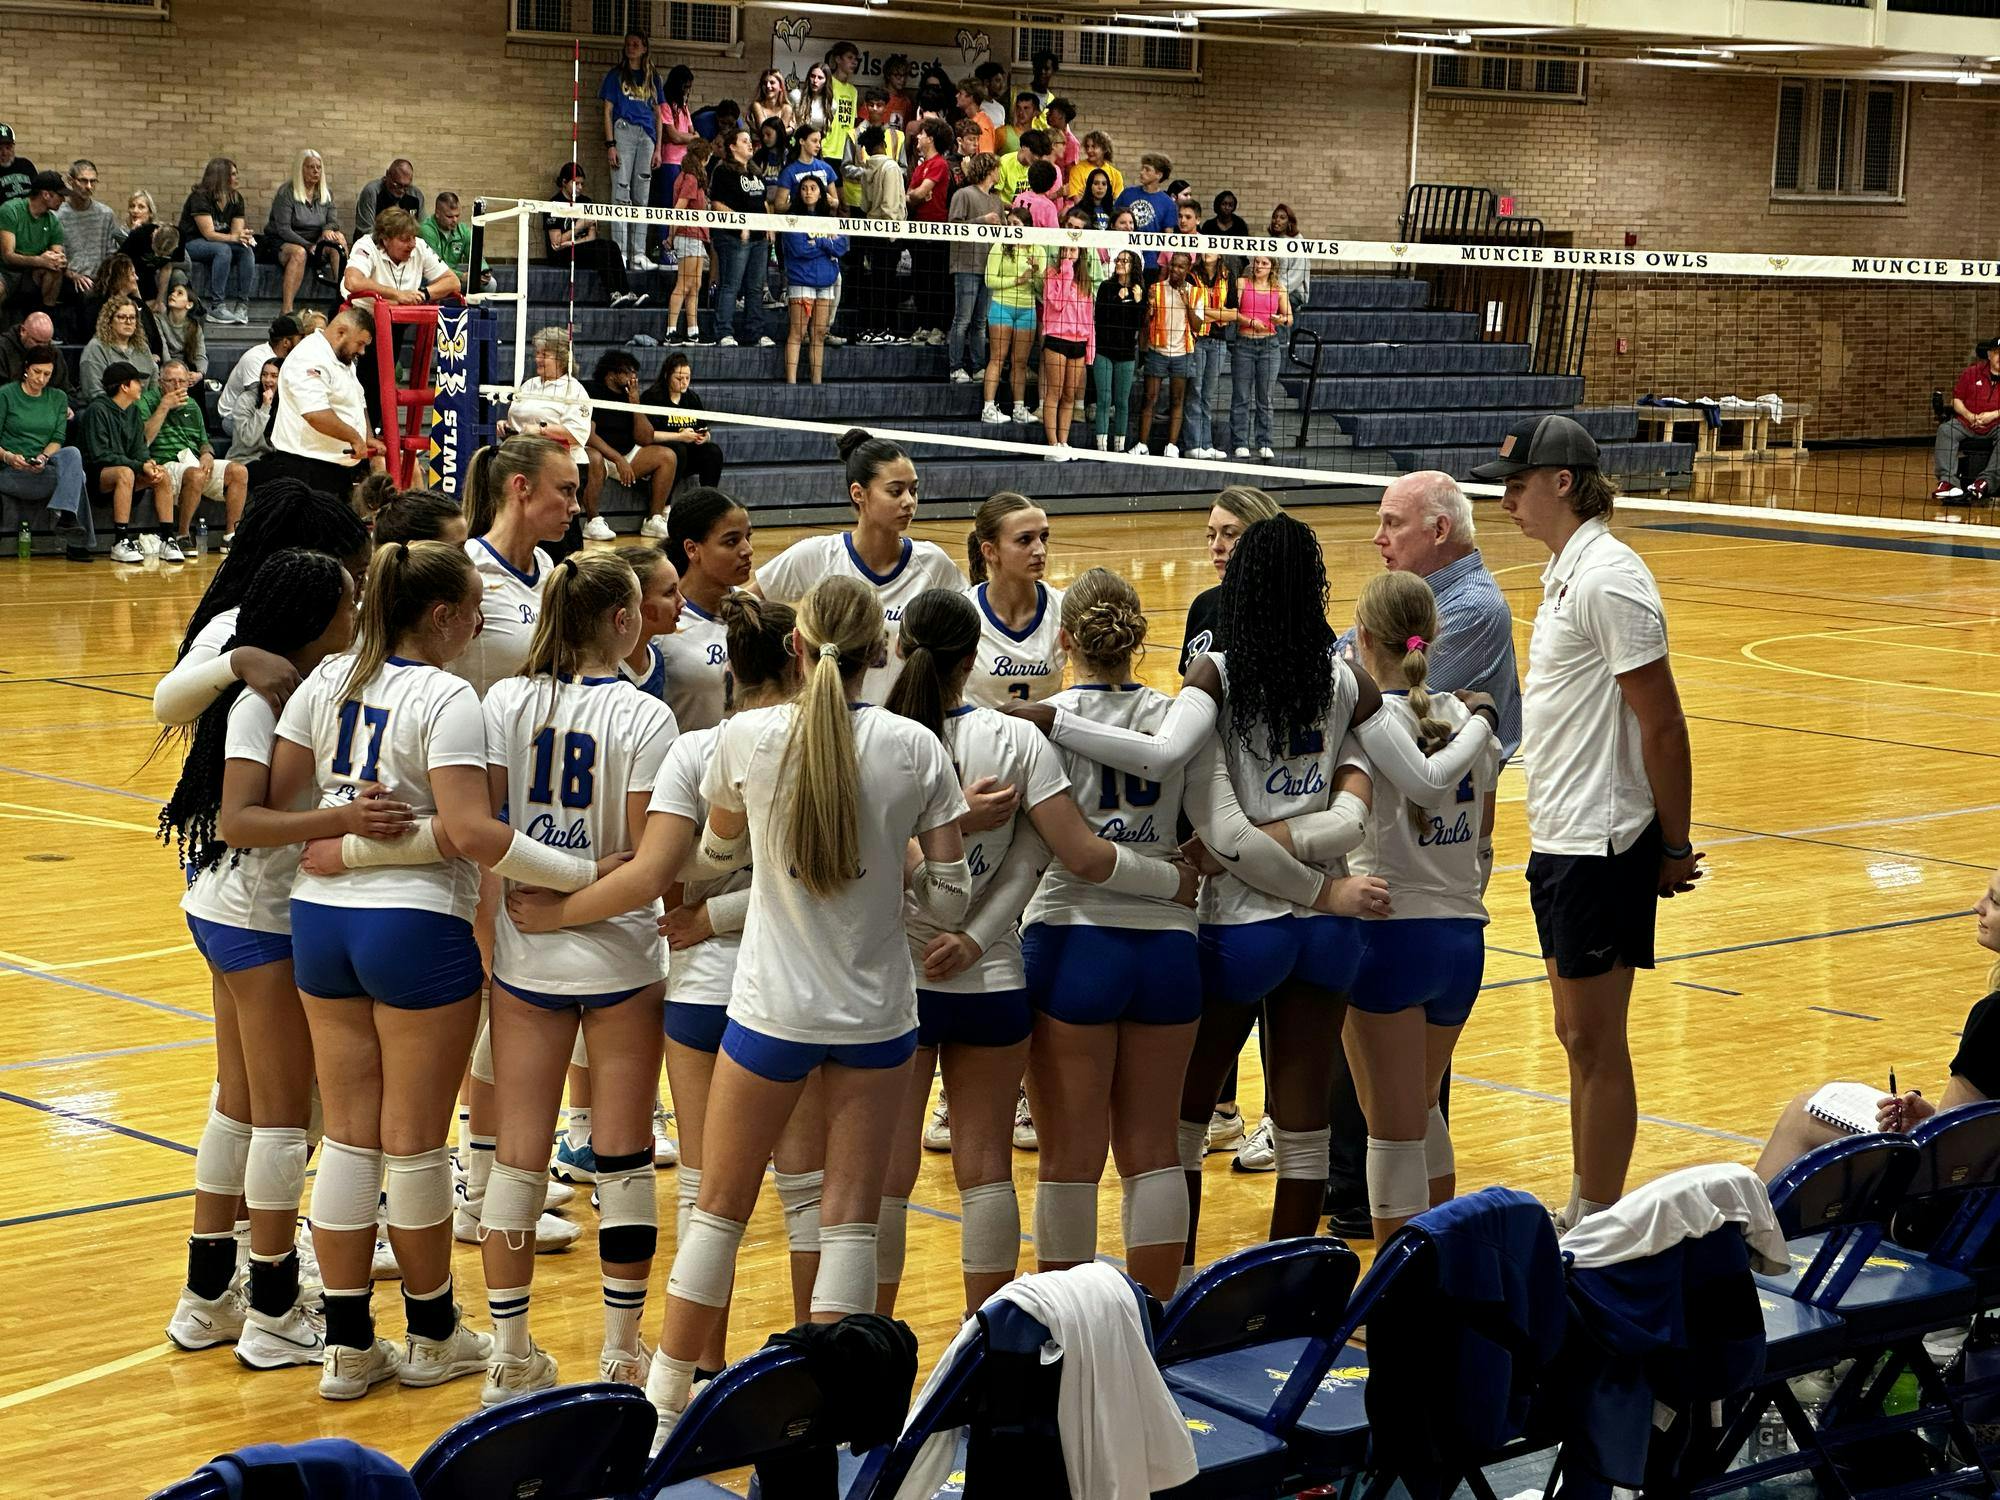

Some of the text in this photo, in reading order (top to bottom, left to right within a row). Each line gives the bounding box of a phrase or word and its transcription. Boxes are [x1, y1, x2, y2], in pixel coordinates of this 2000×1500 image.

[583, 204, 746, 225] MUNCIE BURRIS OWLS
[838, 219, 1023, 239] MUNCIE BURRIS OWLS
[1128, 233, 1339, 255] MUNCIE BURRIS OWLS
[1460, 247, 1708, 268] MUNCIE BURRIS OWLS
[1851, 258, 1949, 275] MUNCIE
[442, 409, 458, 494] OWLS
[989, 655, 1051, 678] Burris
[331, 700, 392, 782] 17
[529, 727, 598, 808] 18
[1266, 761, 1328, 796] Owls
[526, 813, 591, 849] Owls
[1097, 814, 1160, 843] Owls
[1419, 810, 1473, 847] Owls
